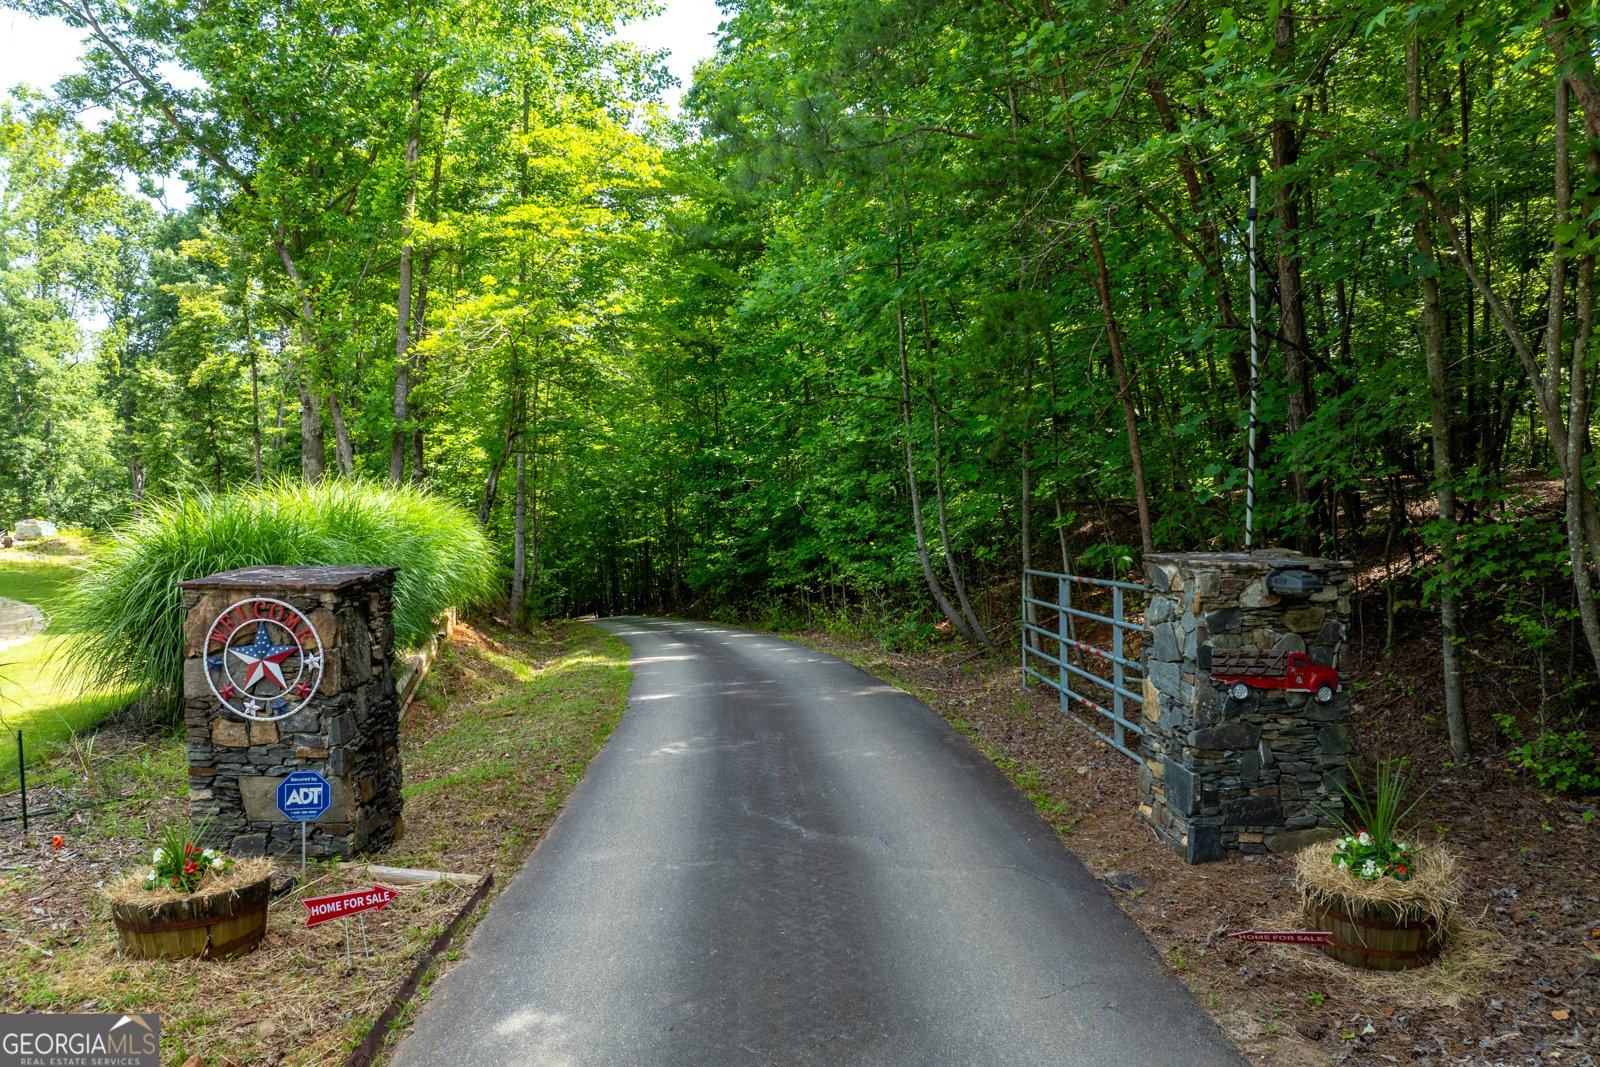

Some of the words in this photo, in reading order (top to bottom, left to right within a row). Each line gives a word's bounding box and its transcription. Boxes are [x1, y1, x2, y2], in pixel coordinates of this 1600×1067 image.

[208, 600, 316, 645] WELCOME
[1215, 648, 1286, 675] 3554
[286, 787, 322, 805] ADT
[311, 901, 342, 916] HOME
[343, 897, 364, 909] FOR
[366, 891, 390, 904] SALE
